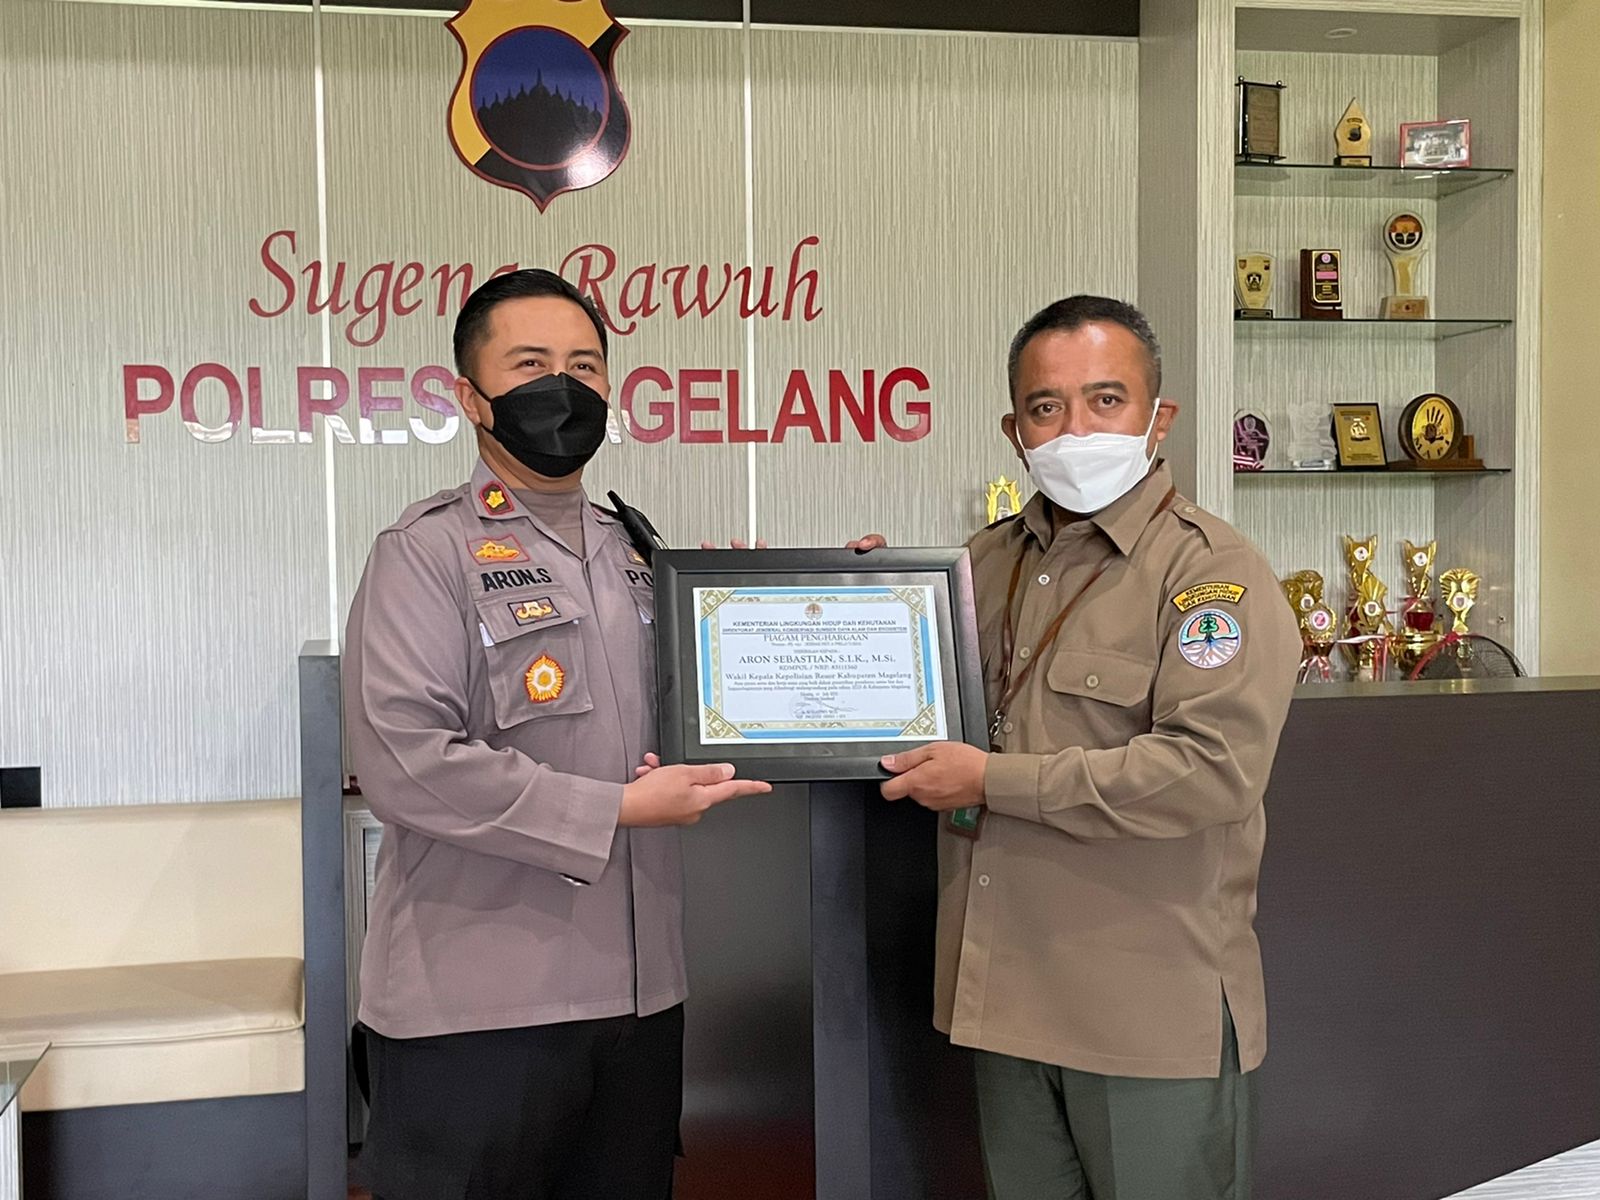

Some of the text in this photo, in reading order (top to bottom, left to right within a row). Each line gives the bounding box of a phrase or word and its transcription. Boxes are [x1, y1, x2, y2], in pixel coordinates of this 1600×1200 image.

[559, 236, 823, 336] Rawuh
[123, 362, 460, 444] POLRES
[480, 567, 552, 592] ARON.S
[763, 633, 869, 642] PIAGAM PENGHARGAAN
[738, 655, 771, 664] ARON
[773, 655, 836, 664] SEBASTIAN,
[748, 673, 774, 681] Kepala
[775, 673, 813, 681] Kepolisian
[837, 672, 877, 680] Kabupaten
[877, 672, 912, 680] Magelang
